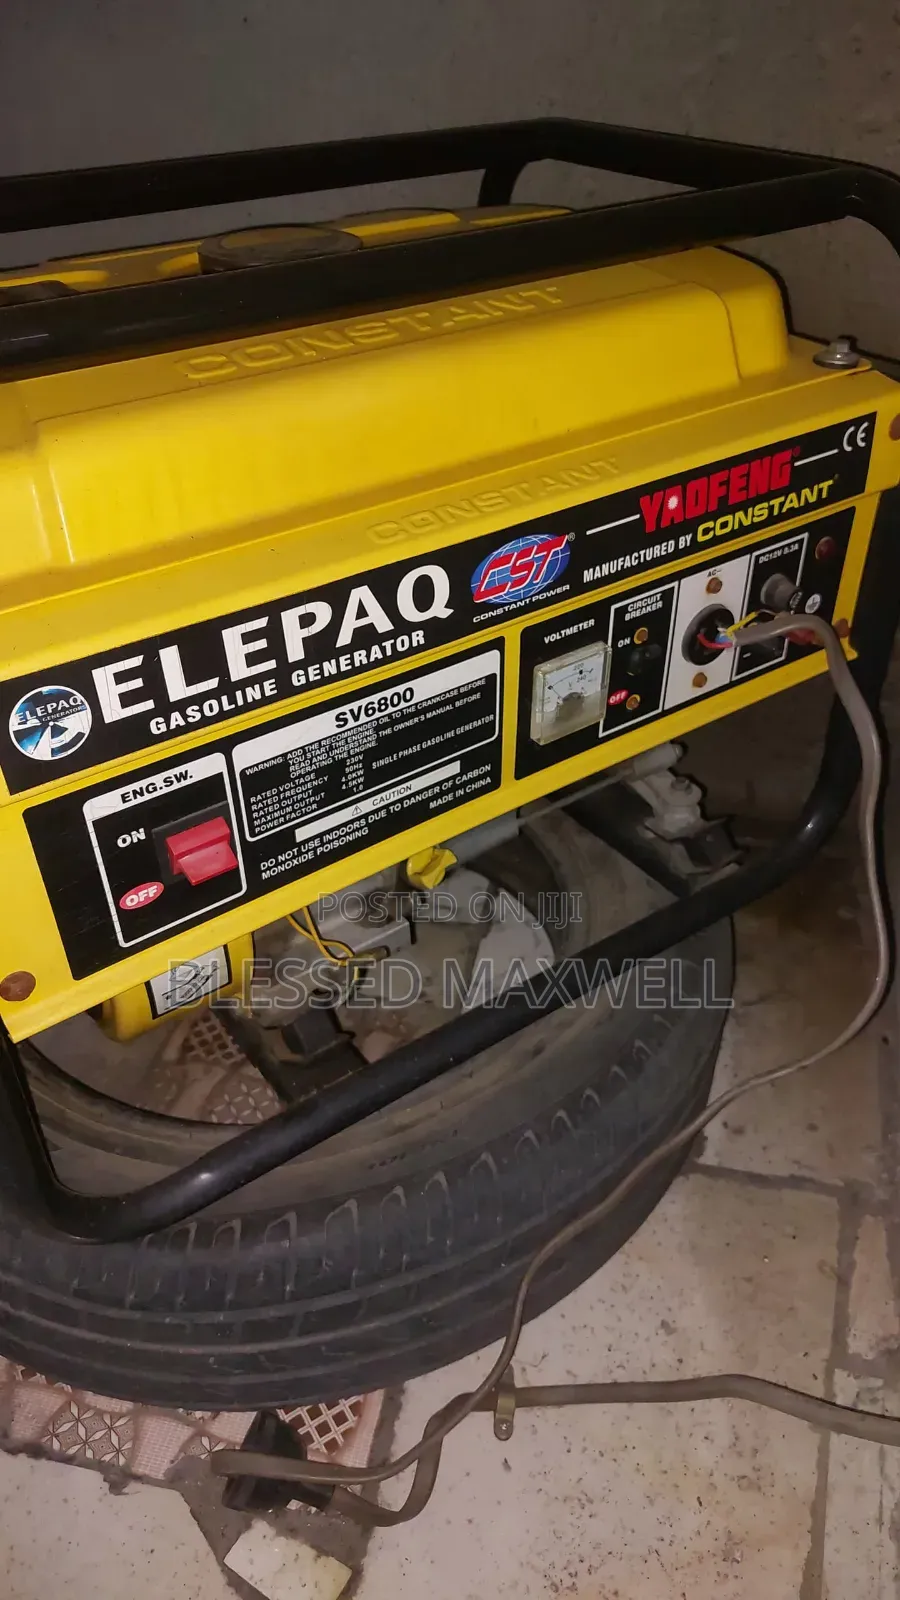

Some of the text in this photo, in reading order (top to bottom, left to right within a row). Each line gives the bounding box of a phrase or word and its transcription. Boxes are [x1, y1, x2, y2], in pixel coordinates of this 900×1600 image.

[175, 286, 563, 379] CONSTANT
[843, 422, 869, 451] CE
[366, 457, 618, 545] CONSTANT
[640, 449, 792, 533] YAOFENG
[583, 480, 833, 583] MANUFACTURED BY CONSTANT
[473, 534, 568, 603] CST
[473, 584, 570, 623] CONSTANT POWER
[624, 600, 663, 621] BREAKER
[627, 593, 662, 613] CIRCUIT
[91, 564, 455, 724] ELEPAQ
[544, 618, 595, 644] VOLTMETER
[617, 637, 631, 649] ON
[150, 630, 426, 736] GASOLINE GENERATOR
[609, 691, 626, 703] OFF
[16, 696, 82, 722] ELEPAQ
[245, 678, 486, 775] WARNING: ADD THE RECOMMENDED OIL TO THE CRANKCASE BEFORE
[335, 687, 415, 729] SV6800
[289, 692, 481, 772] READ AND UNDERSTAND THE OWNER'S MANUAL BEFORE
[289, 728, 376, 766] YOU START THE ENGINE.
[372, 714, 494, 769] SINGLE PHASE GASOLINE GENERATOR
[250, 754, 364, 803] RATED VOLTAGE 230V
[290, 741, 379, 778] OPERATING THE ENGINE.
[120, 769, 193, 804] ENG.SW.
[251, 795, 279, 811] RATED
[280, 775, 329, 801] FREQUENCY
[253, 769, 364, 819] RATED OUTPUT 4.0KW
[372, 784, 412, 807] CAUTION
[429, 776, 492, 809] MADE IN CHINA
[254, 807, 293, 826] MAXIMUM
[294, 792, 325, 812] OUTPUT
[255, 785, 363, 834] POWER FACTOR 1.0
[260, 764, 492, 871] DO NOT USE INDOORS DUE TO DANGER OF CARBON
[117, 828, 146, 848] ON
[262, 827, 369, 880] MONOXIDE POISONING
[125, 885, 158, 907] OFF
